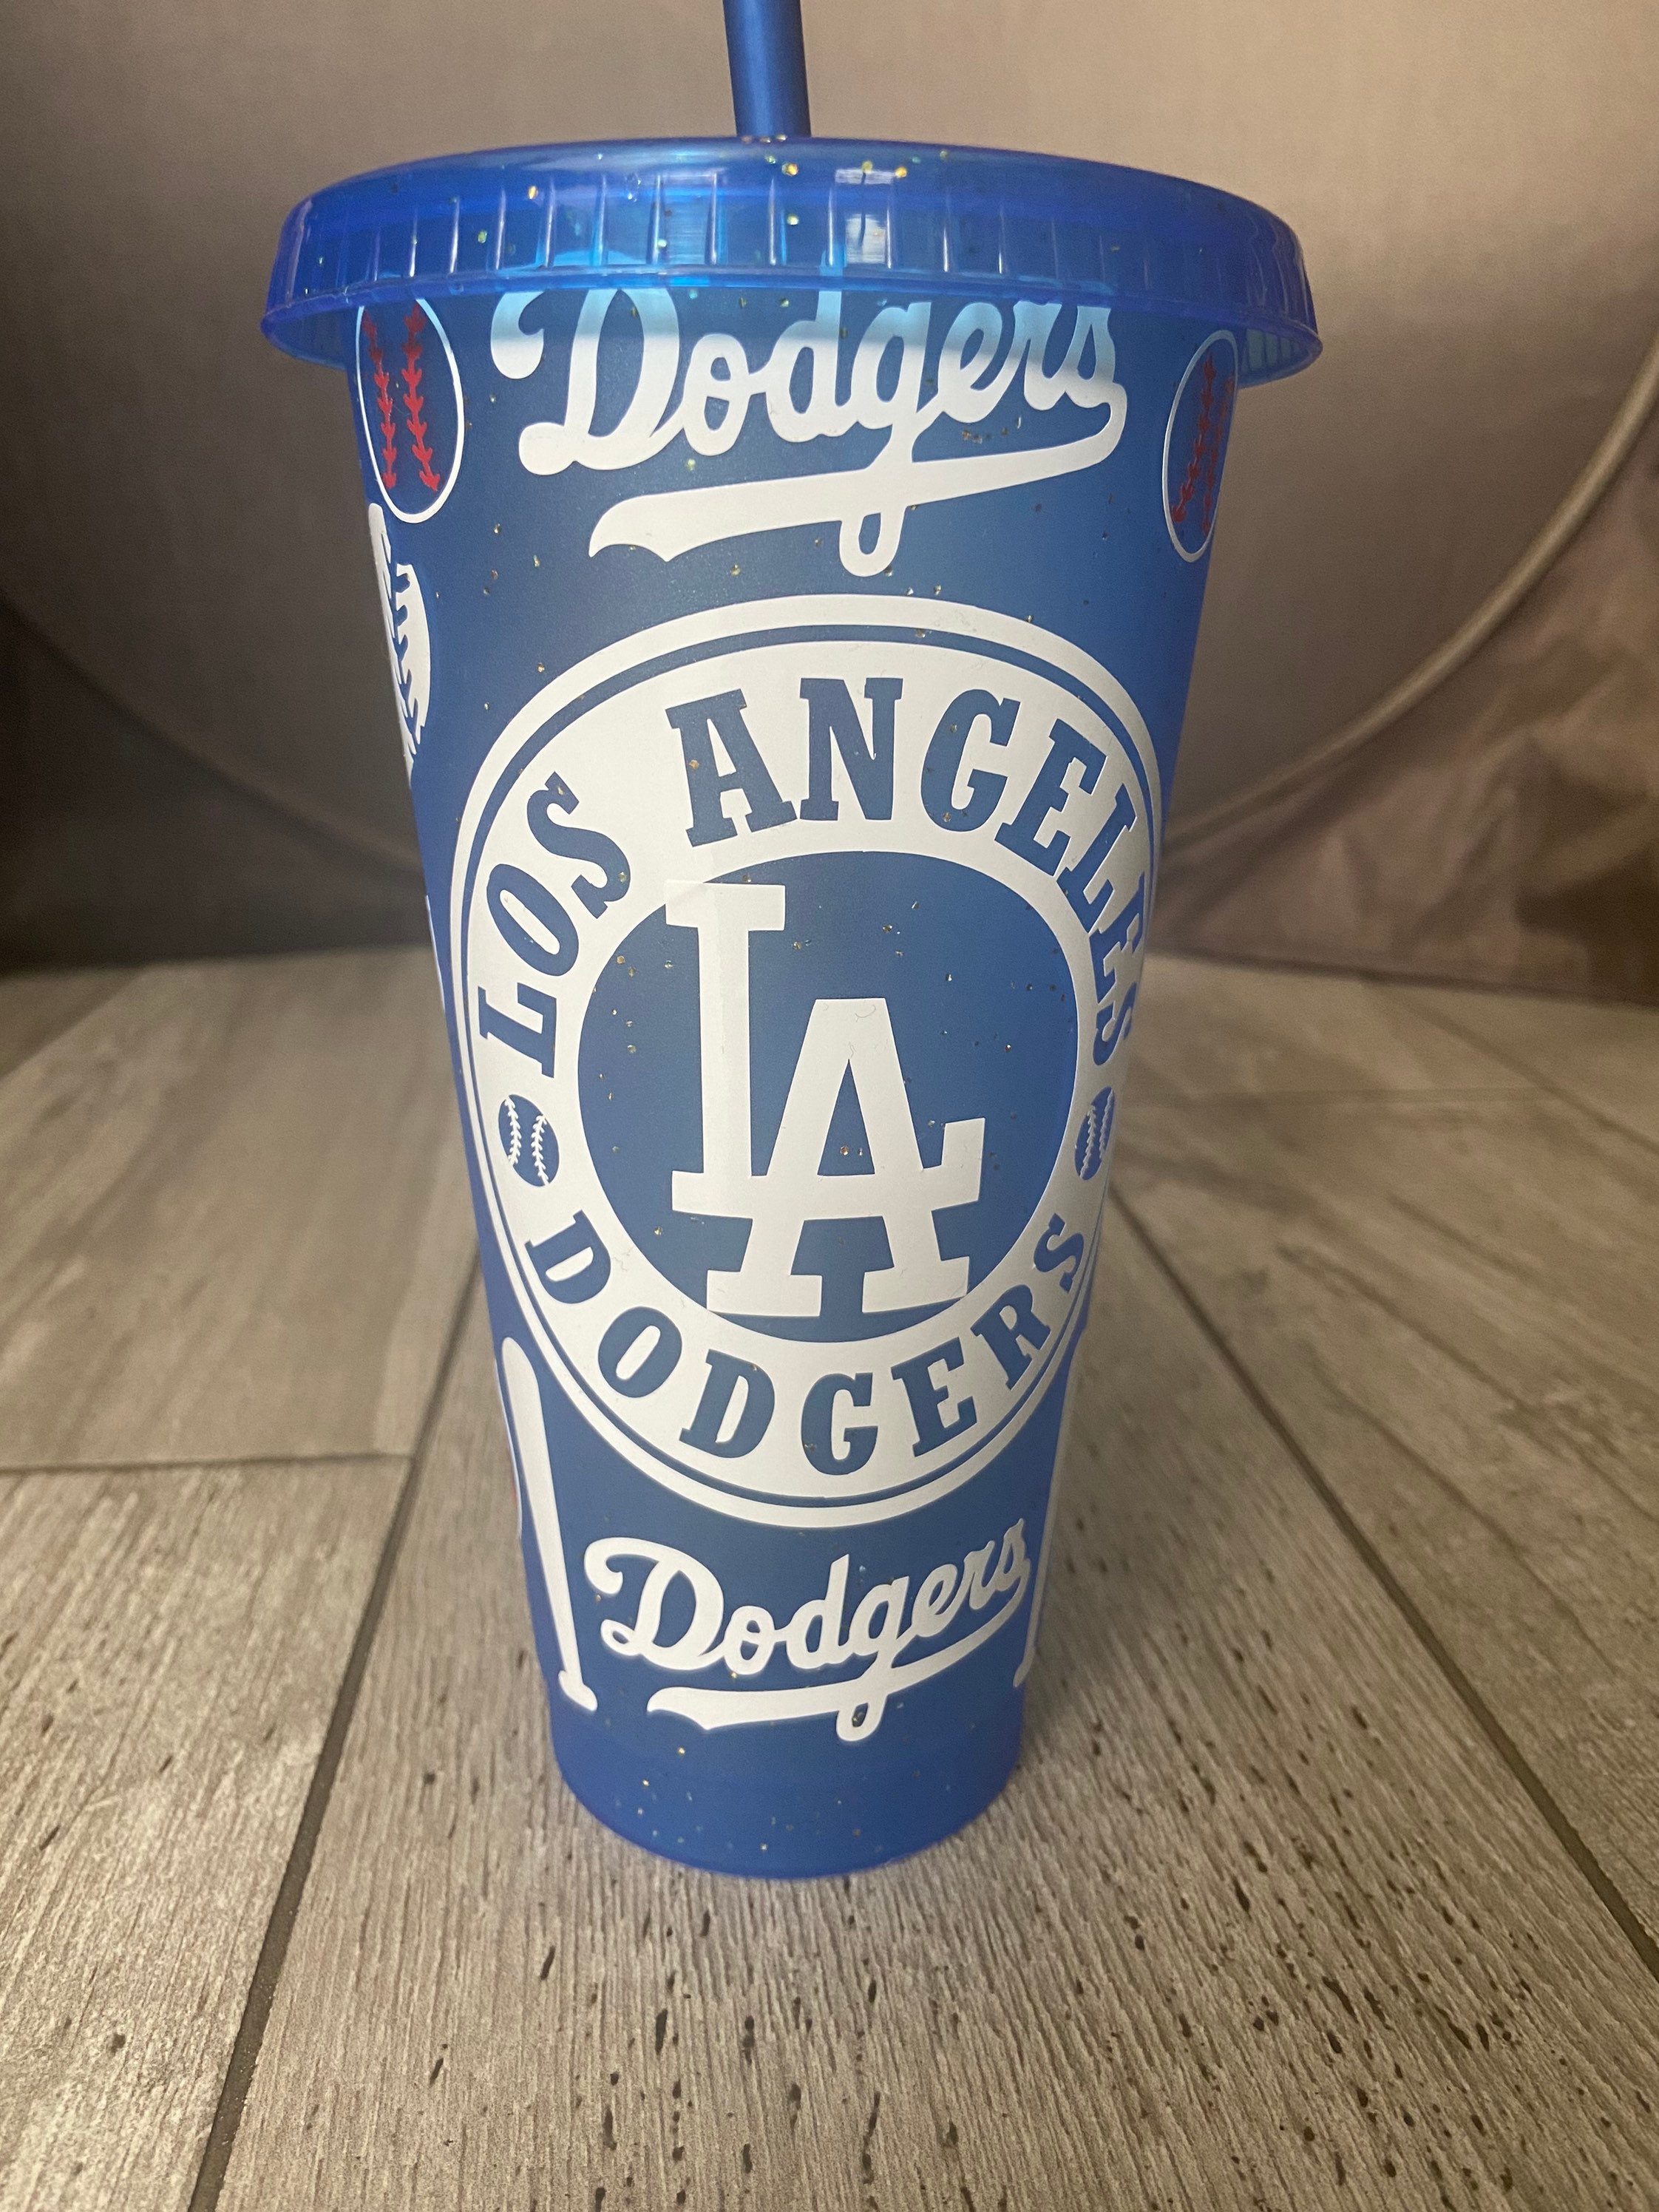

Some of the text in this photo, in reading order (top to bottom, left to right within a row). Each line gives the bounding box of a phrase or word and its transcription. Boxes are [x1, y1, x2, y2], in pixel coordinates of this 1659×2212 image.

[489, 285, 1128, 577] Dodgers
[476, 676, 1145, 1079] LOS ANGELES
[665, 881, 985, 1317] LA
[524, 1210, 1085, 1476] DODGERS
[583, 1517, 1031, 1743] Dodgers
